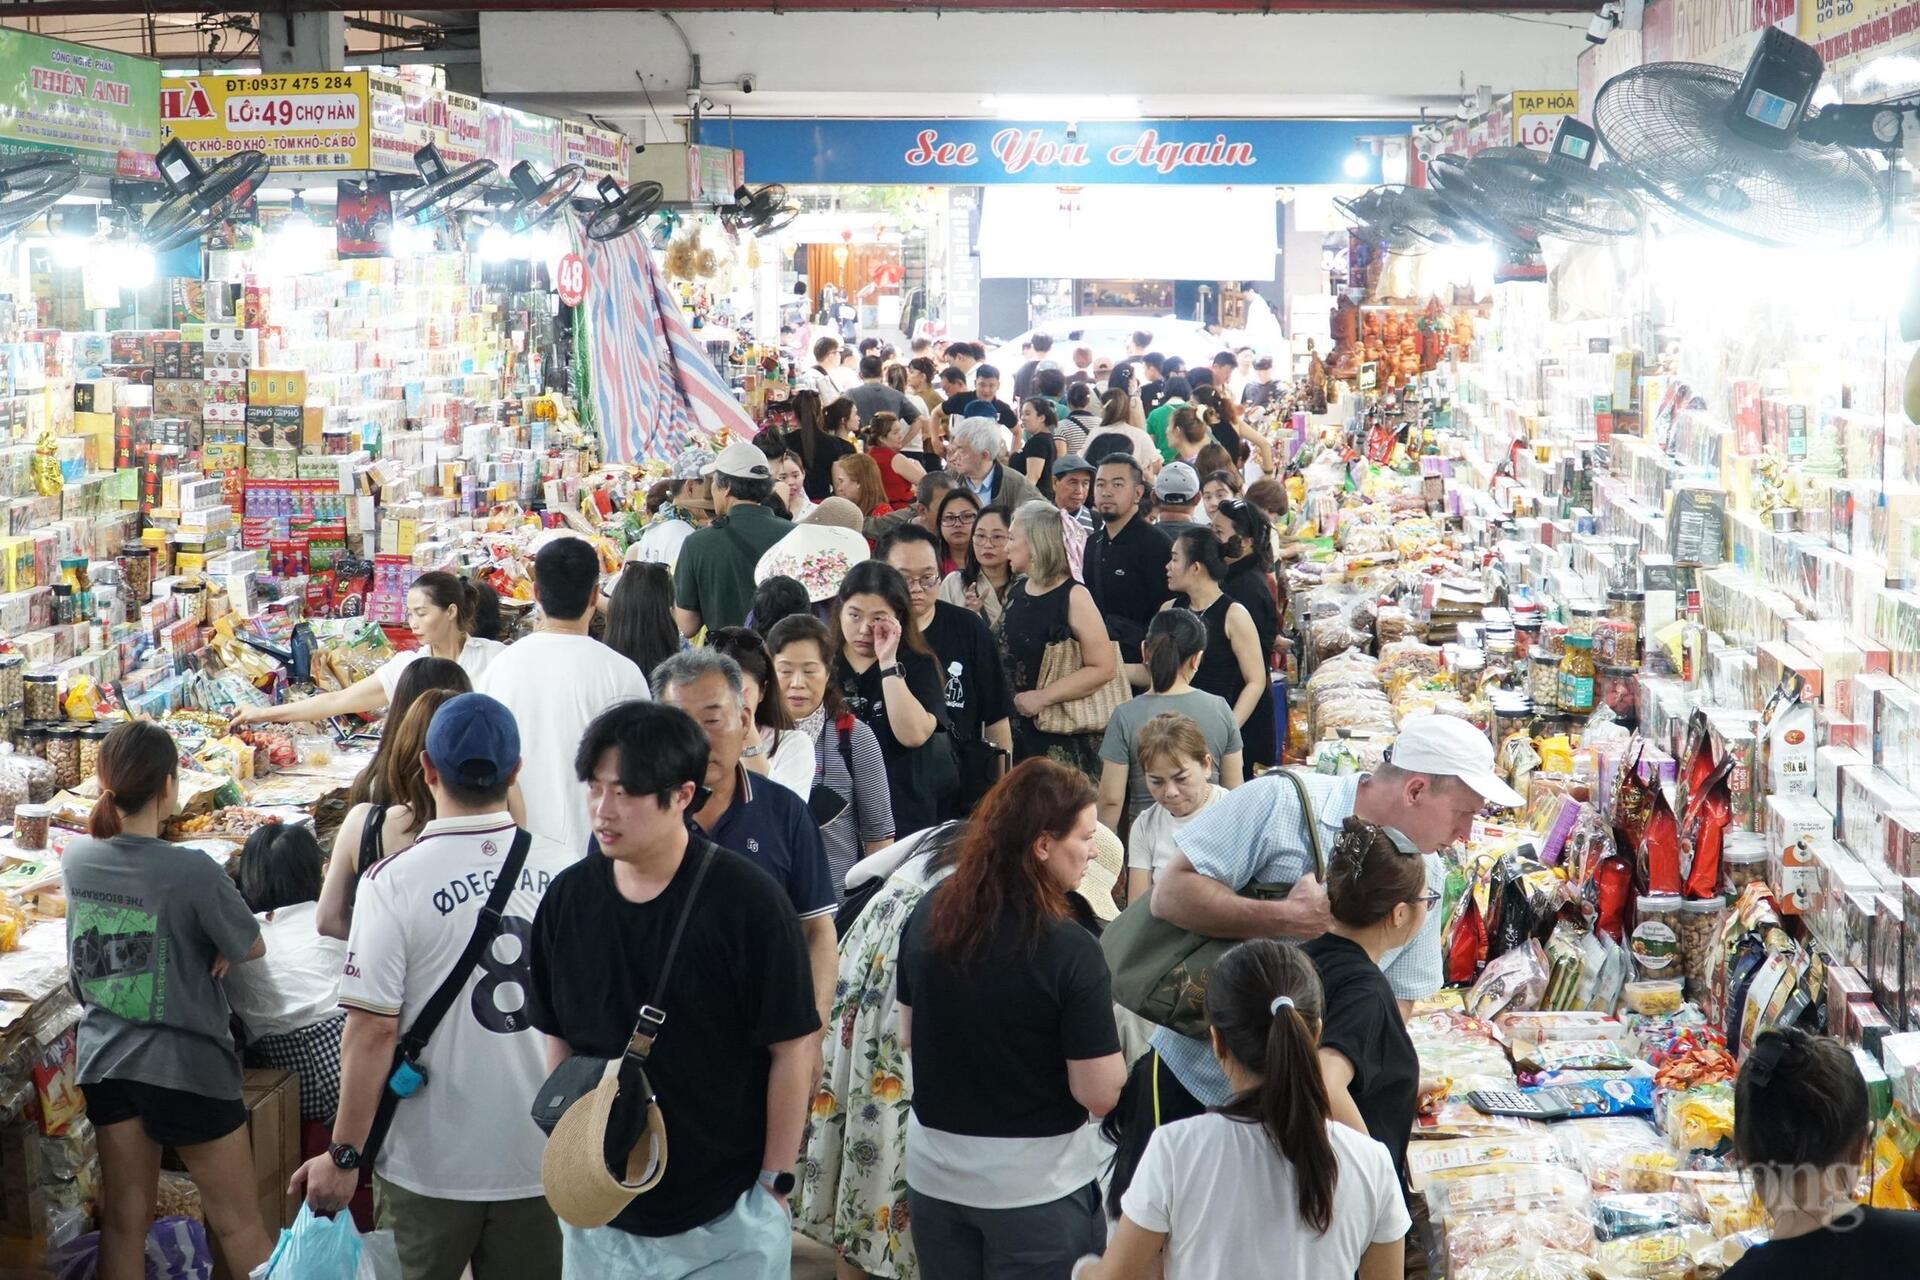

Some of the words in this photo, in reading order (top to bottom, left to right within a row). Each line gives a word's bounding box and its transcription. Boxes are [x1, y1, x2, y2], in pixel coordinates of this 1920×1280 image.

[31, 67, 87, 100] THIỆN
[92, 80, 129, 106] ANH
[226, 78, 287, 92] ĐT:0937
[292, 77, 319, 90] 475
[325, 76, 352, 89] 284
[295, 104, 325, 124] CHỢ
[327, 99, 355, 119] HÀN
[1519, 97, 1544, 112] TẠP
[1547, 92, 1575, 108] HÓA
[244, 135, 266, 150] KHÔ
[274, 135, 295, 149] TÔM
[905, 129, 979, 166] See
[991, 128, 1091, 174] You
[1106, 128, 1257, 174] Again
[560, 260, 584, 293] 48
[126, 896, 144, 908] THE
[432, 868, 557, 917] ØDEGAR
[471, 915, 534, 1034] 8
